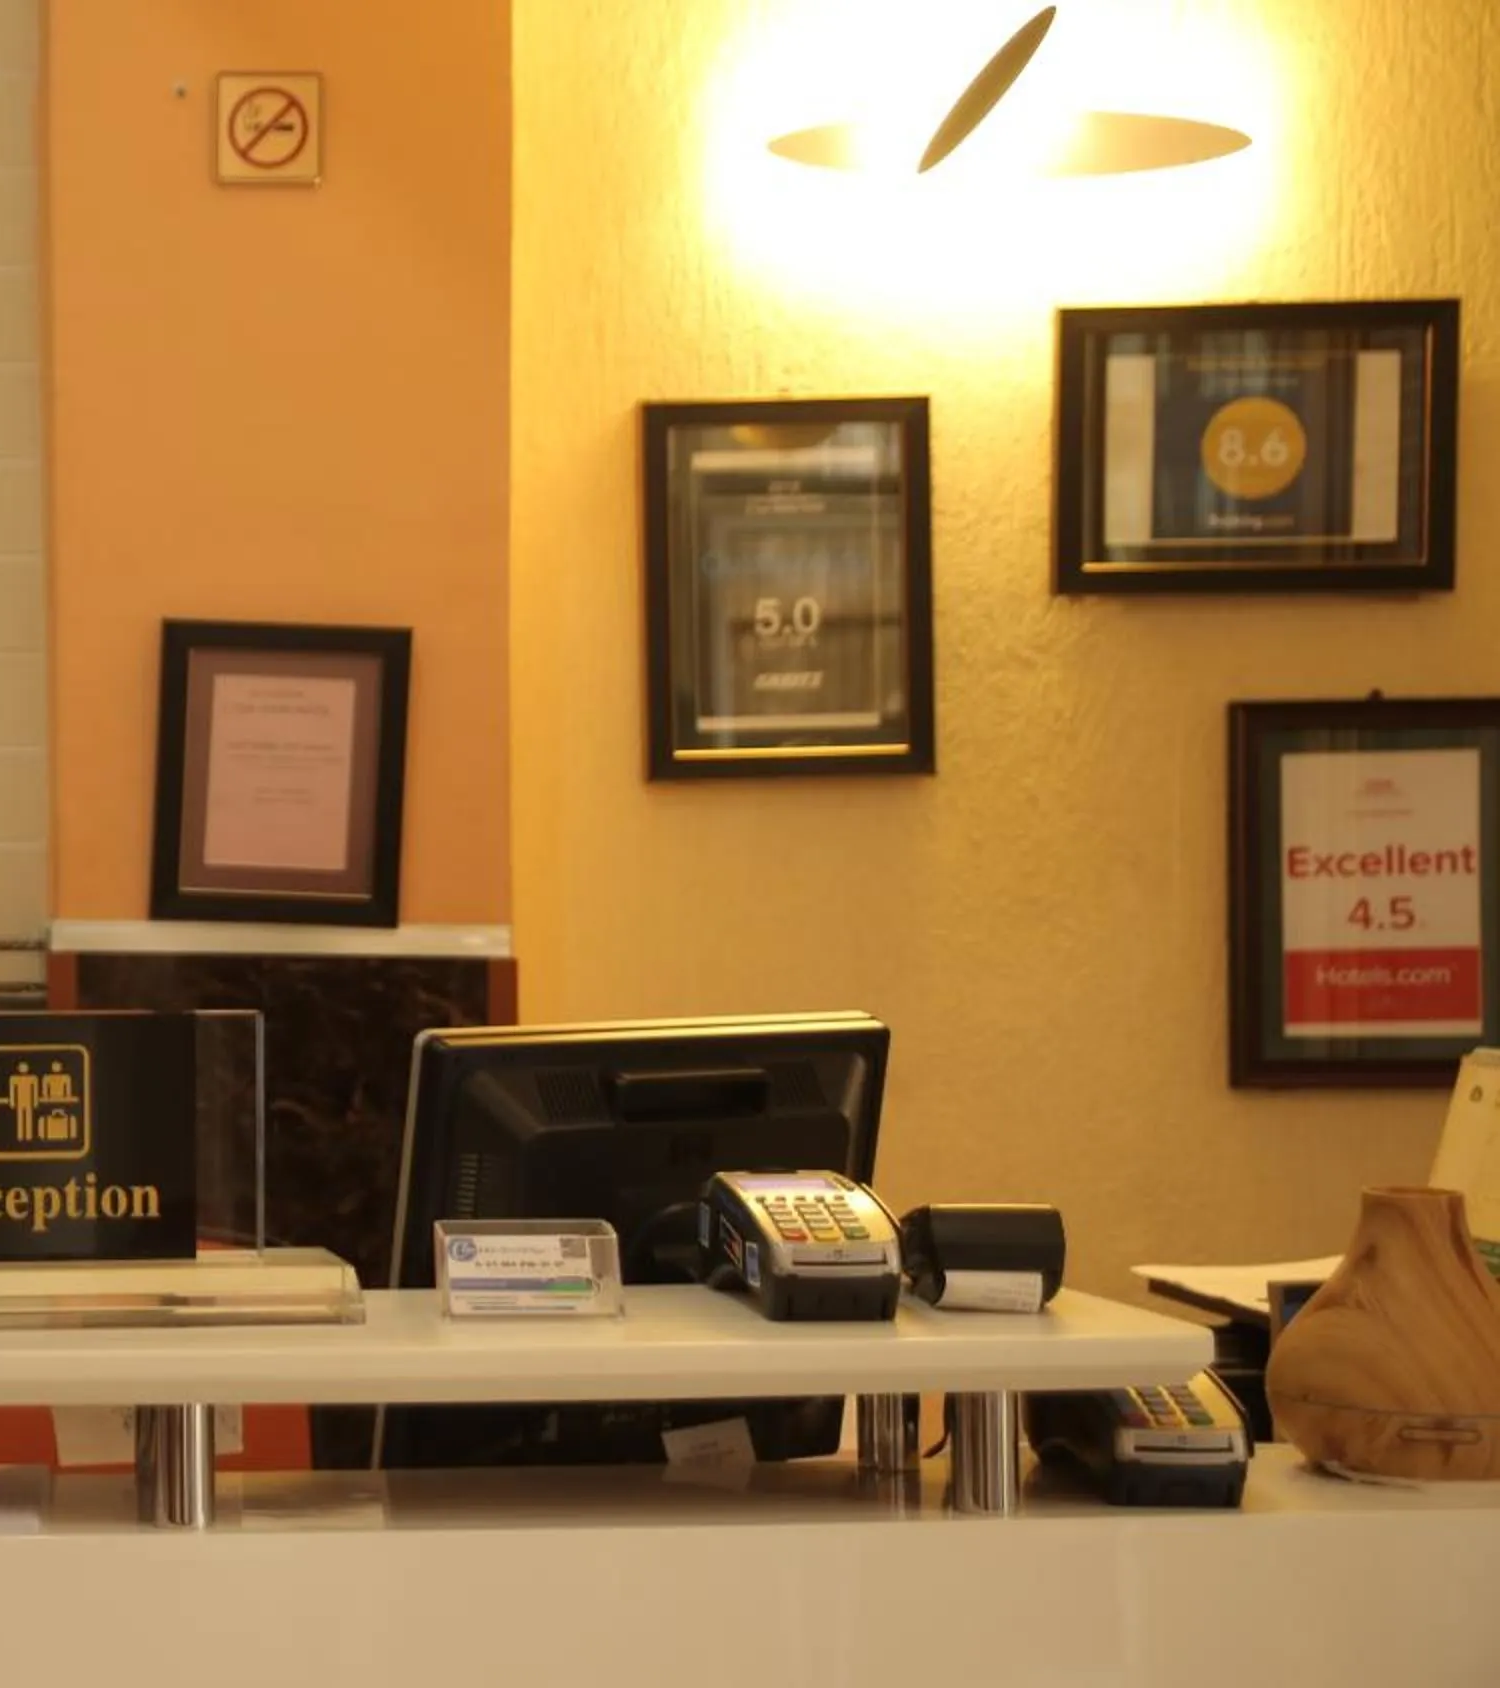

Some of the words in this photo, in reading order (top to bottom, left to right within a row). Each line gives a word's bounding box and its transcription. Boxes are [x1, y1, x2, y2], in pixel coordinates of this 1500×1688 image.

[1217, 427, 1288, 467] 8.6
[755, 597, 820, 636] 5.0
[1286, 845, 1475, 880] Excellent
[1347, 895, 1416, 931] 4.5
